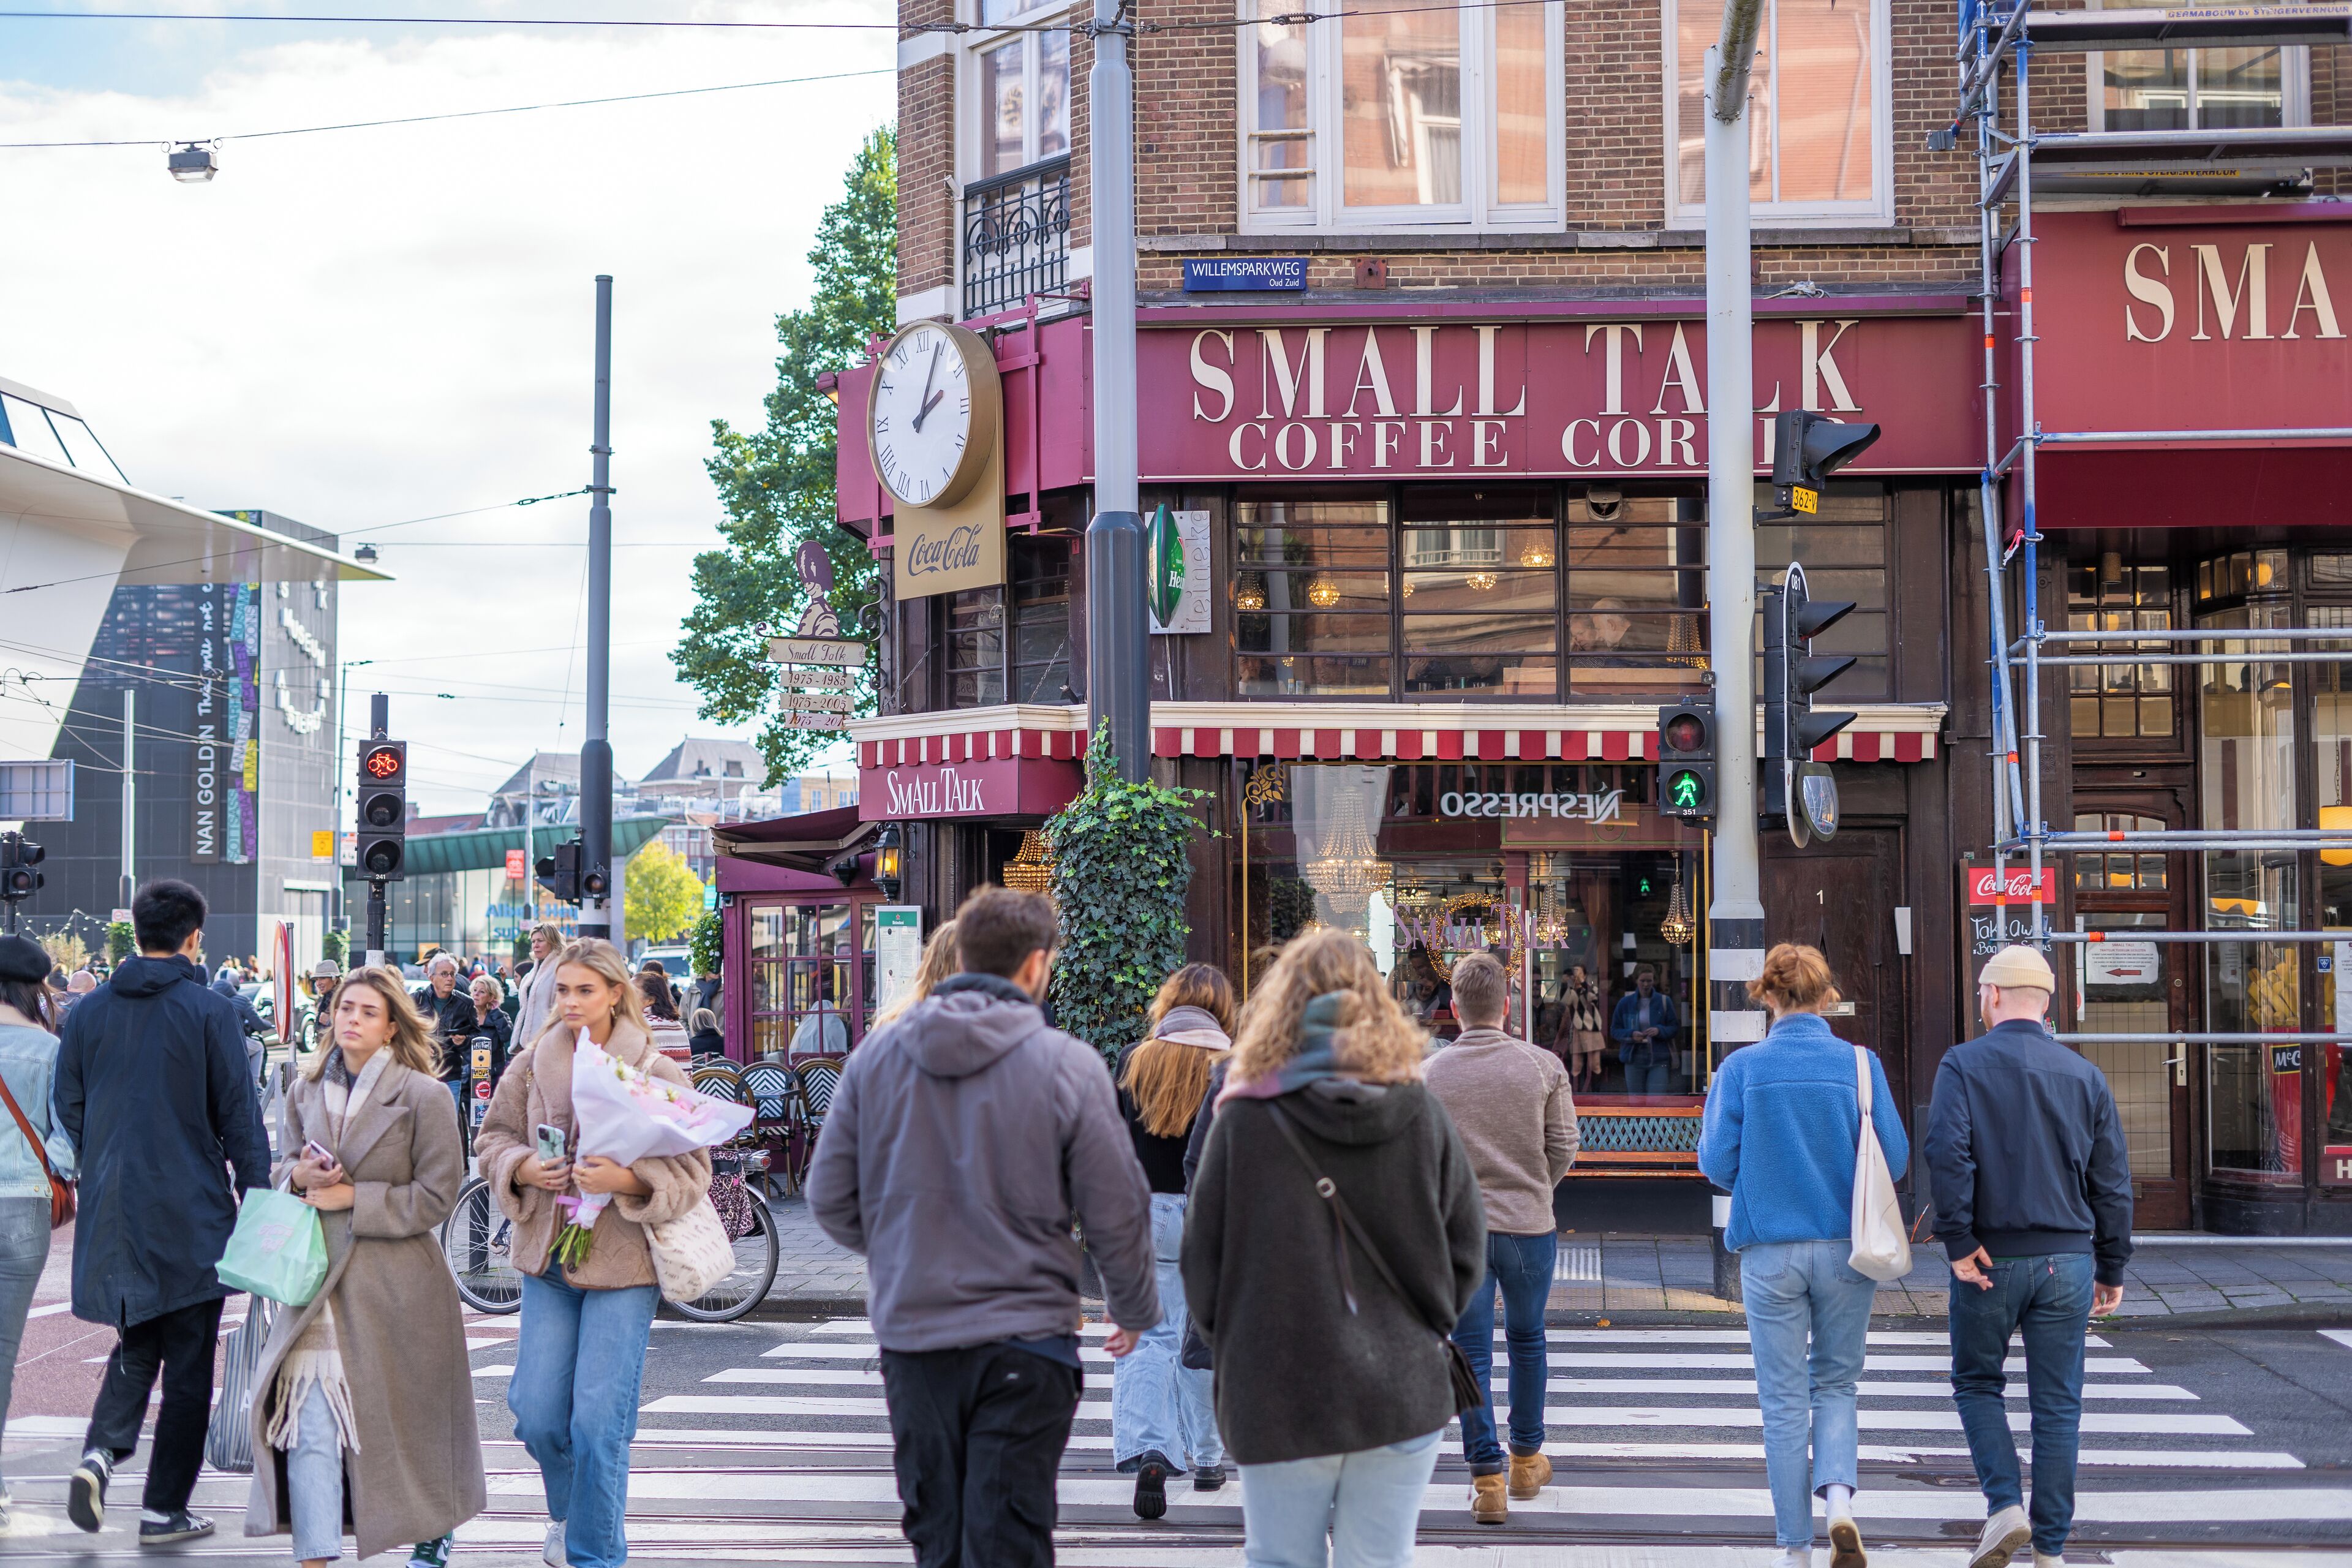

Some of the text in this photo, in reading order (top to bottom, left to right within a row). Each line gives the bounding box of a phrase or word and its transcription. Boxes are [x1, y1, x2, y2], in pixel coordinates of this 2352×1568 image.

[1192, 262, 1300, 276] WILLEMSPARKWEG
[1189, 325, 1525, 423] SMALL
[1229, 421, 1507, 471] COFFEE
[908, 523, 985, 576] Coca-Cola
[1791, 574, 1801, 591] 081
[198, 601, 214, 632] not
[246, 606, 257, 655] KOONS
[279, 607, 326, 669] MUSEUM
[788, 643, 847, 663] Small Talk
[197, 725, 215, 805] GOLDIN
[887, 767, 985, 815] SMALL TALK
[197, 811, 214, 855] NAN
[1817, 889, 1823, 904] 1
[1977, 874, 2046, 896] Coc-Col
[1392, 903, 1570, 950] SMALL TALK
[1970, 917, 2007, 940] Tak
